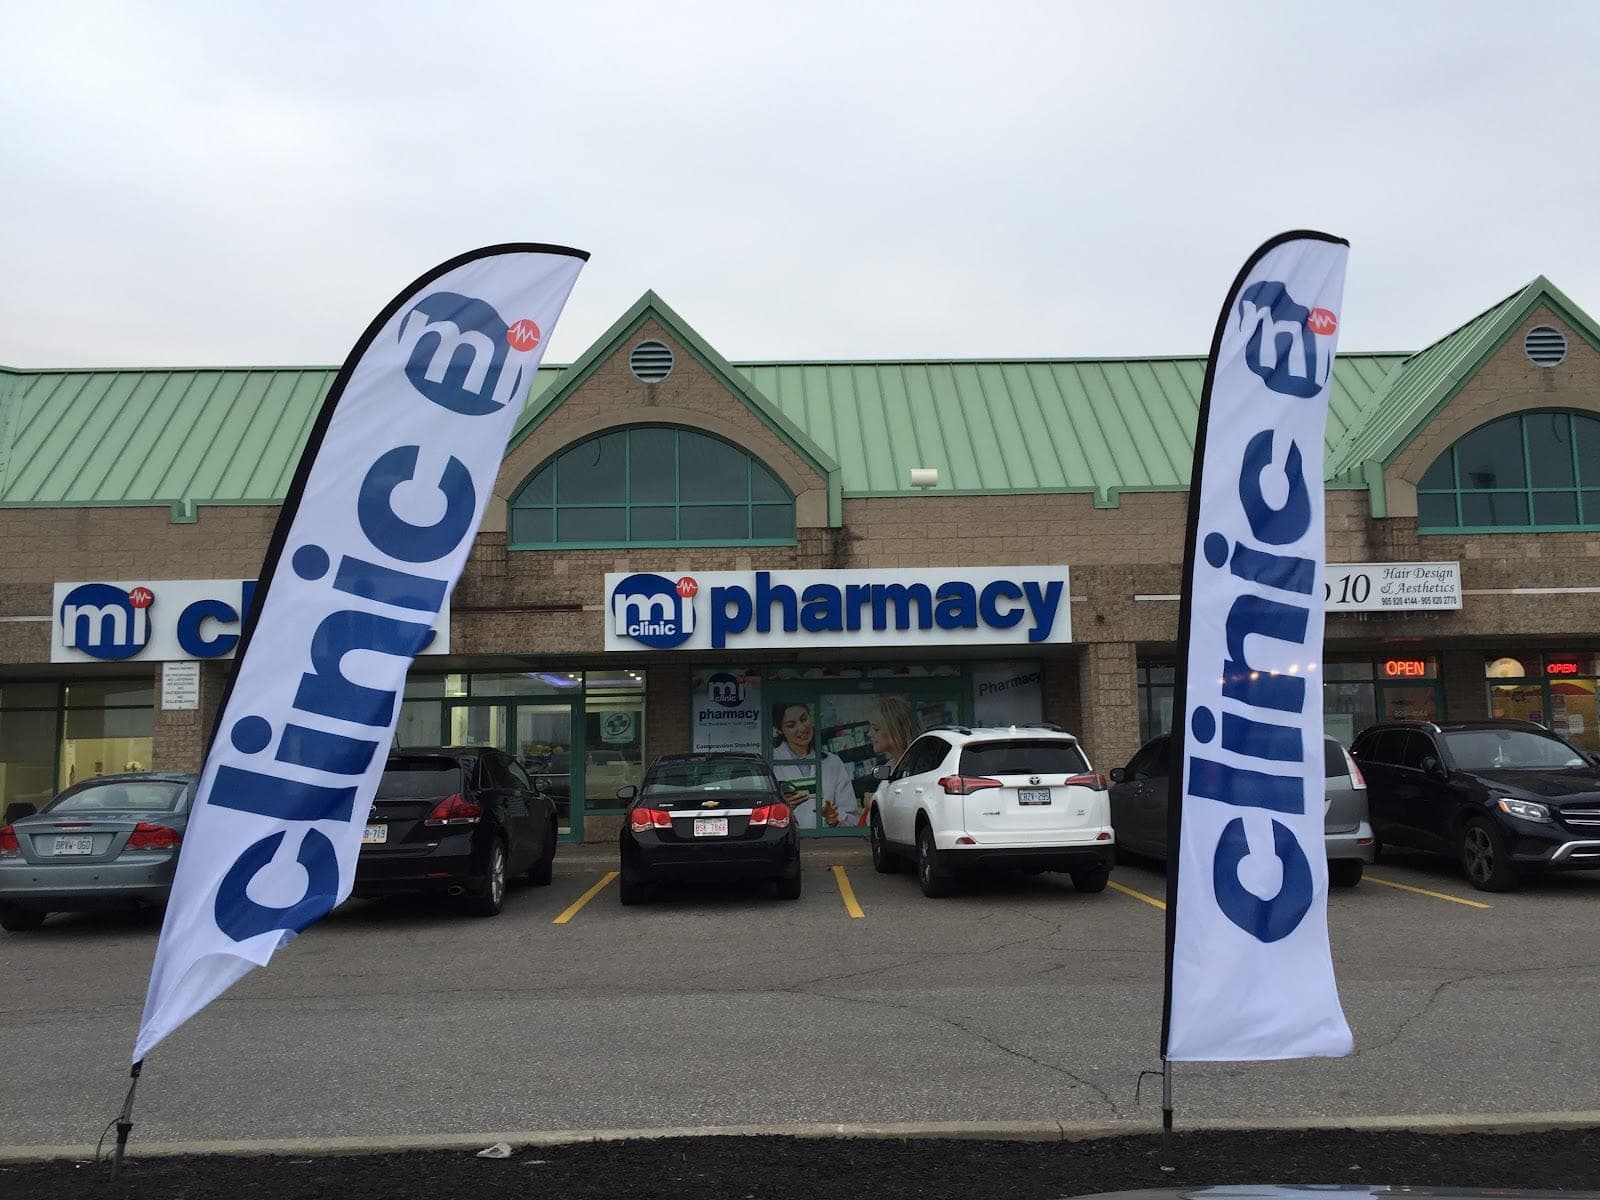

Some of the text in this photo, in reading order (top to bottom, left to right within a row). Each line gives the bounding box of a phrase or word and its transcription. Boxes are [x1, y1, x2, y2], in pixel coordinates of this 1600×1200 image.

[397, 308, 542, 405] mi
[1382, 566, 1453, 581] Hair Design
[1336, 574, 1371, 604] 10
[1380, 580, 1456, 595] & Aesthetics
[62, 586, 154, 647] mi
[614, 571, 1065, 649] mi pharmacy
[628, 621, 676, 636] clinic
[1386, 660, 1425, 676] OPEN
[1547, 663, 1577, 673] OPEN
[207, 444, 477, 942] clinic
[979, 671, 1041, 696] Pharmacy
[1187, 428, 1315, 944] clinic
[699, 708, 760, 722] pharmacy
